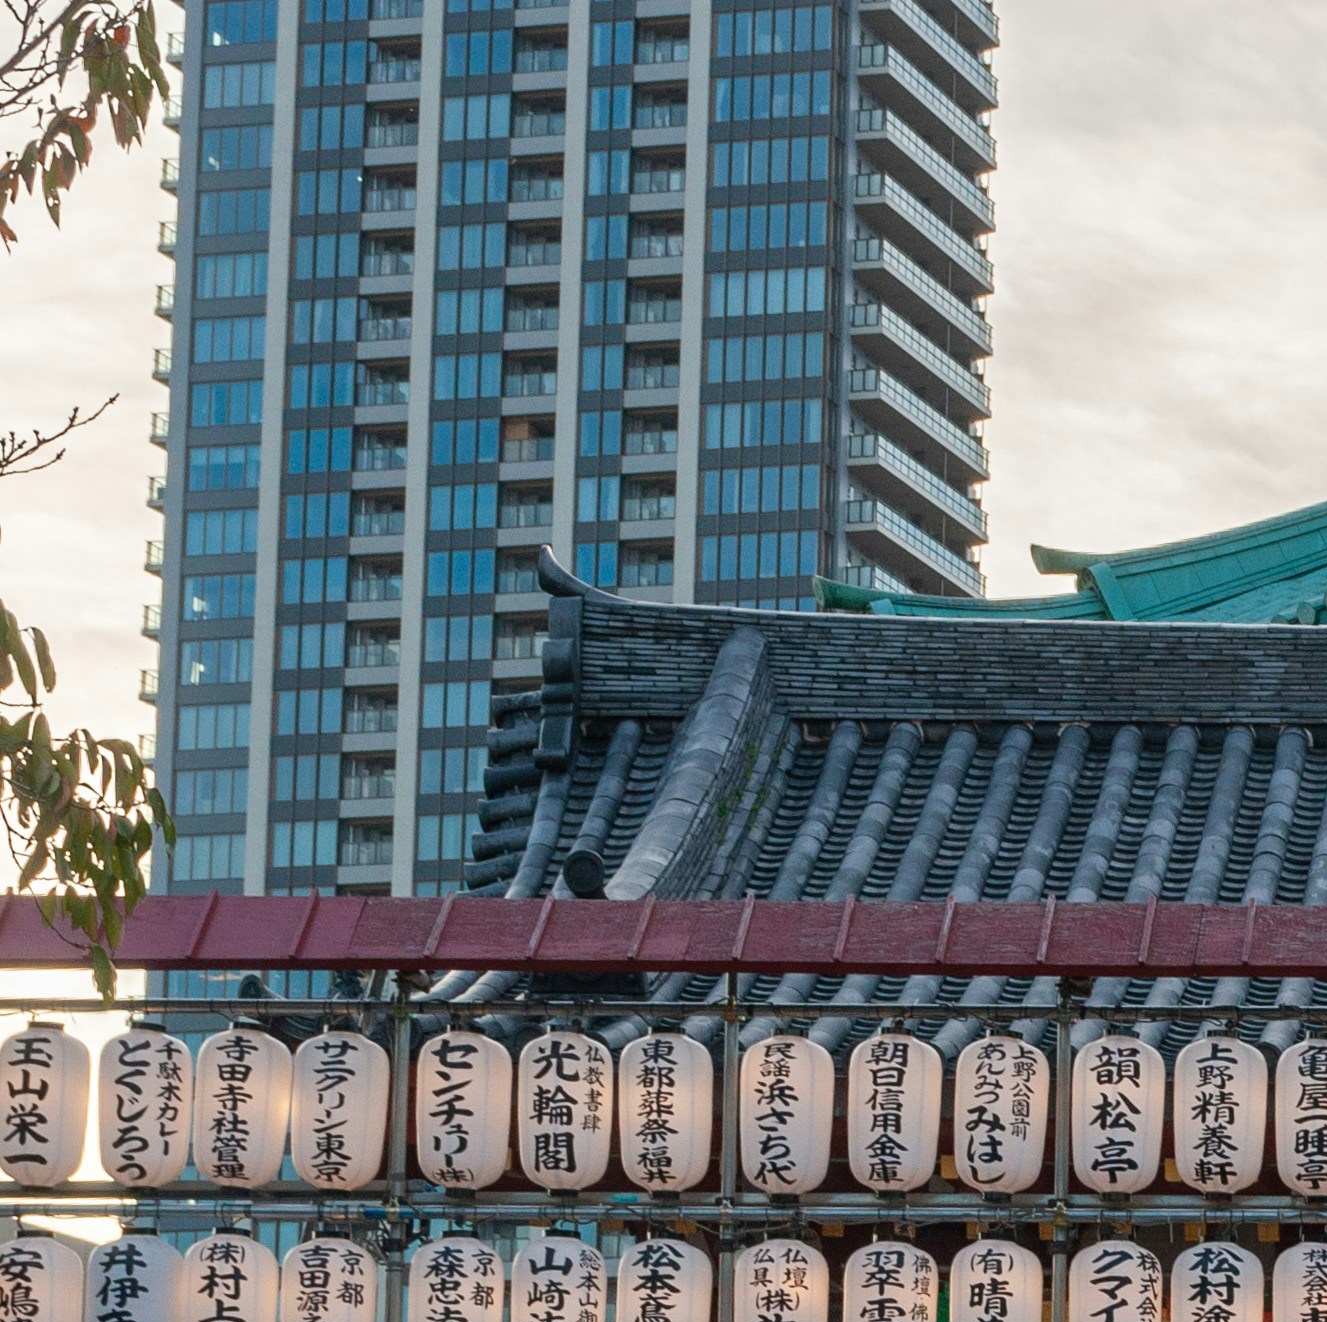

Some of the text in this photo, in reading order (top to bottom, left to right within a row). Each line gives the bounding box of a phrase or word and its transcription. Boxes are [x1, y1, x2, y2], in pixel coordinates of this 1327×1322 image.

[4, 1037, 53, 1165] 玉山栄一
[112, 1039, 151, 1181] とくじろう
[154, 1043, 183, 1156] 千駄木カレー
[208, 1036, 259, 1181] 寺田寺社管理
[311, 1041, 359, 1182] サニクリーン東京
[429, 1039, 479, 1182] センチュリー(株)
[527, 1041, 581, 1173] 光輪閣
[579, 1045, 605, 1134] 仏教書肆
[635, 1039, 679, 1183] 東都葬祭福井
[754, 1042, 799, 1185] 民謡浜さち代
[866, 1040, 909, 1184] 朝日信用金庫
[965, 1042, 1006, 1184] あんみつみはし
[1009, 1045, 1037, 1141] 上野公園前
[1089, 1046, 1141, 1184] 韻松亭
[1191, 1043, 1239, 1185] 上野精養軒
[336, 1249, 365, 1308] 京都
[469, 1249, 495, 1310] 京都
[750, 1248, 775, 1288] 仏具
[780, 1248, 809, 1291] 仏壇
